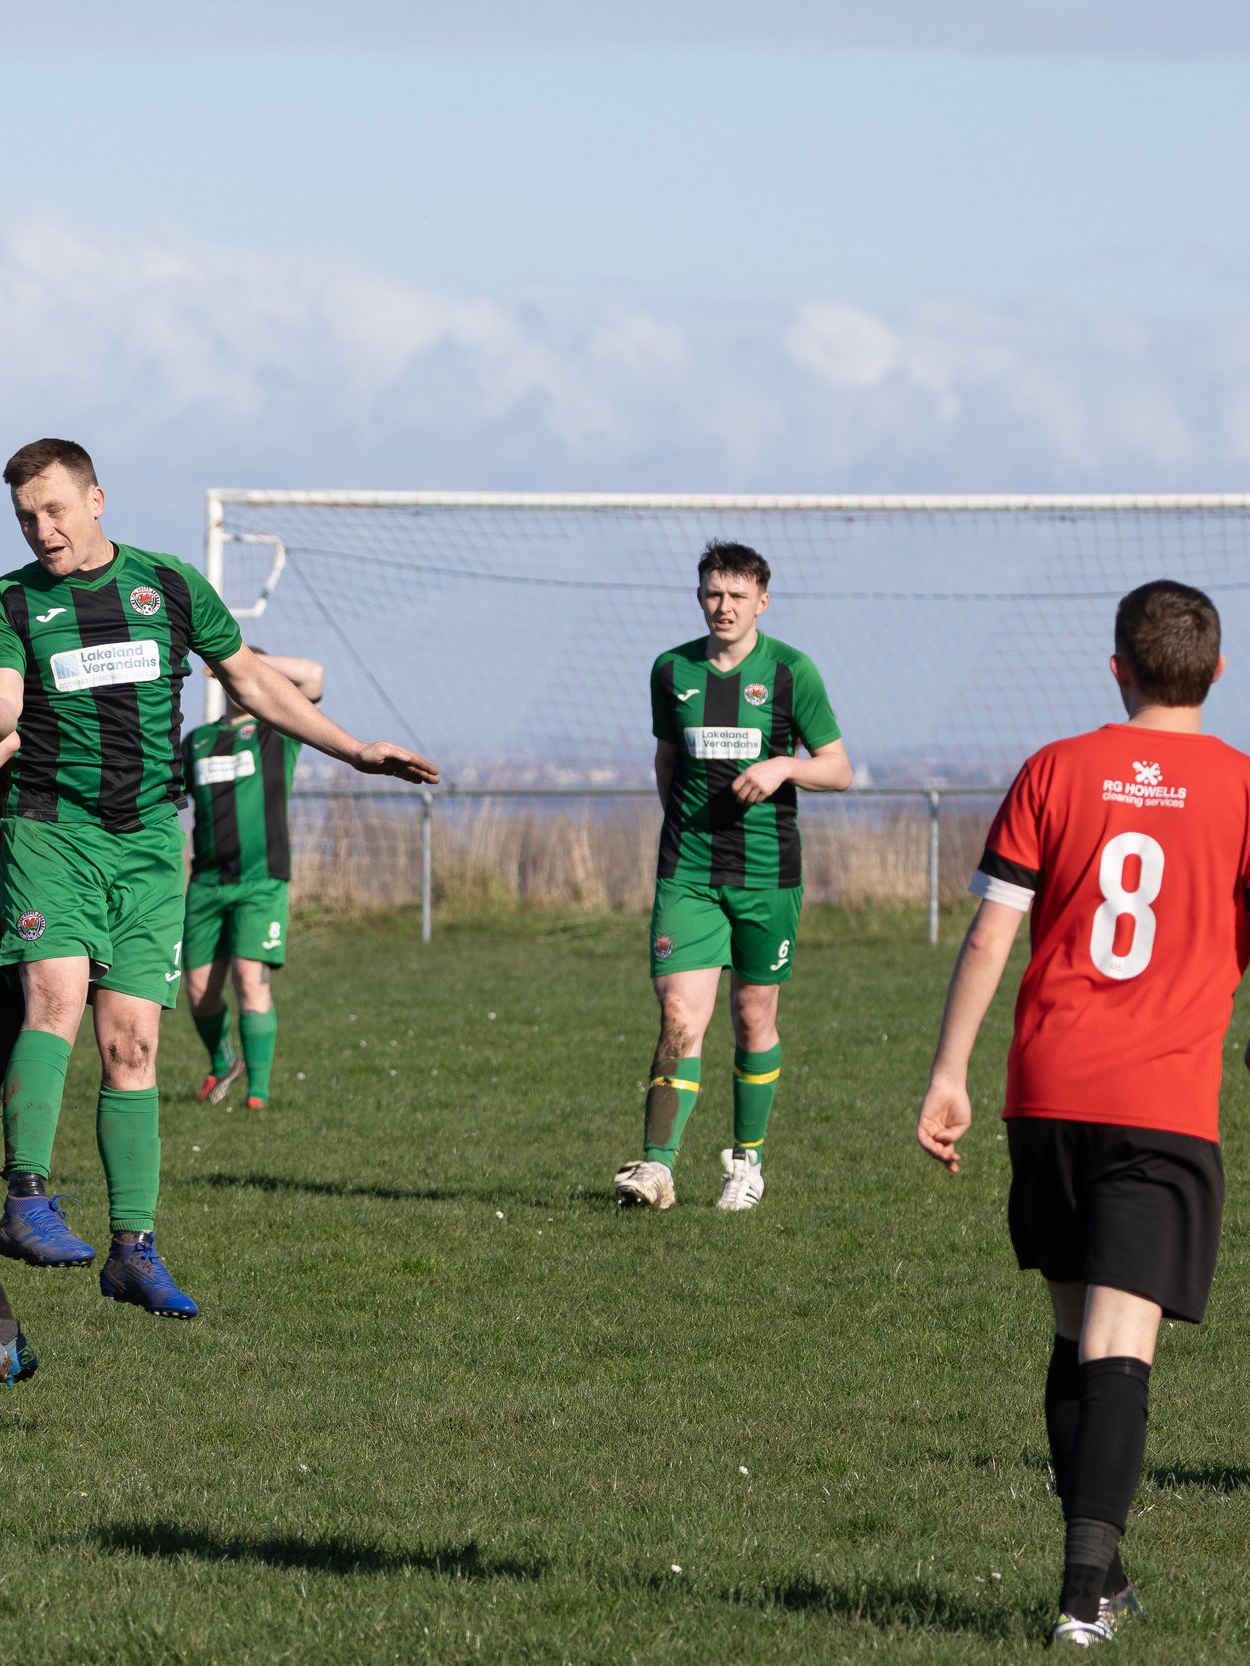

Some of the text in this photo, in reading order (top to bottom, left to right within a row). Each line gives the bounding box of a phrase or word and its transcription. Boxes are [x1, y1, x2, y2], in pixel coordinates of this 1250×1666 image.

[81, 645, 143, 662] Lakeland
[83, 657, 156, 674] Verandahs
[702, 730, 749, 739] Lakeland
[703, 740, 759, 748] Verandahs
[1103, 780, 1187, 799] RG HOWELLS
[1102, 792, 1185, 808] cleaning services
[1090, 832, 1165, 980] 8
[269, 921, 281, 939] 8
[778, 939, 790, 958] 6
